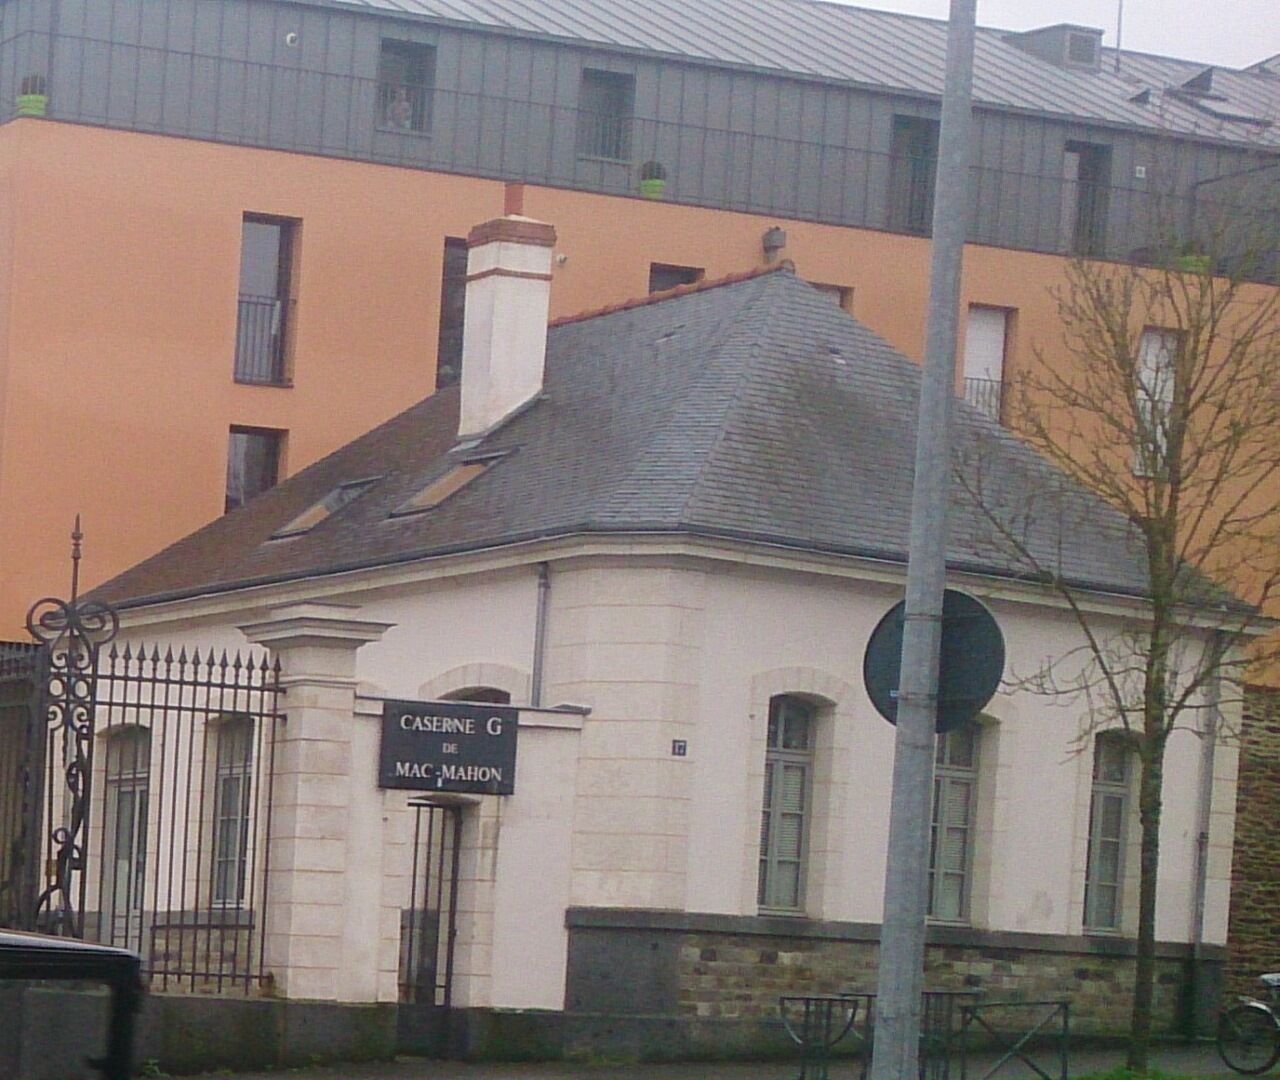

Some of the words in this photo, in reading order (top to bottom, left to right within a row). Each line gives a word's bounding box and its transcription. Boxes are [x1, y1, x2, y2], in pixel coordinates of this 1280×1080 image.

[400, 714, 475, 734] CASERNE
[486, 717, 502, 736] G
[442, 743, 458, 754] DE
